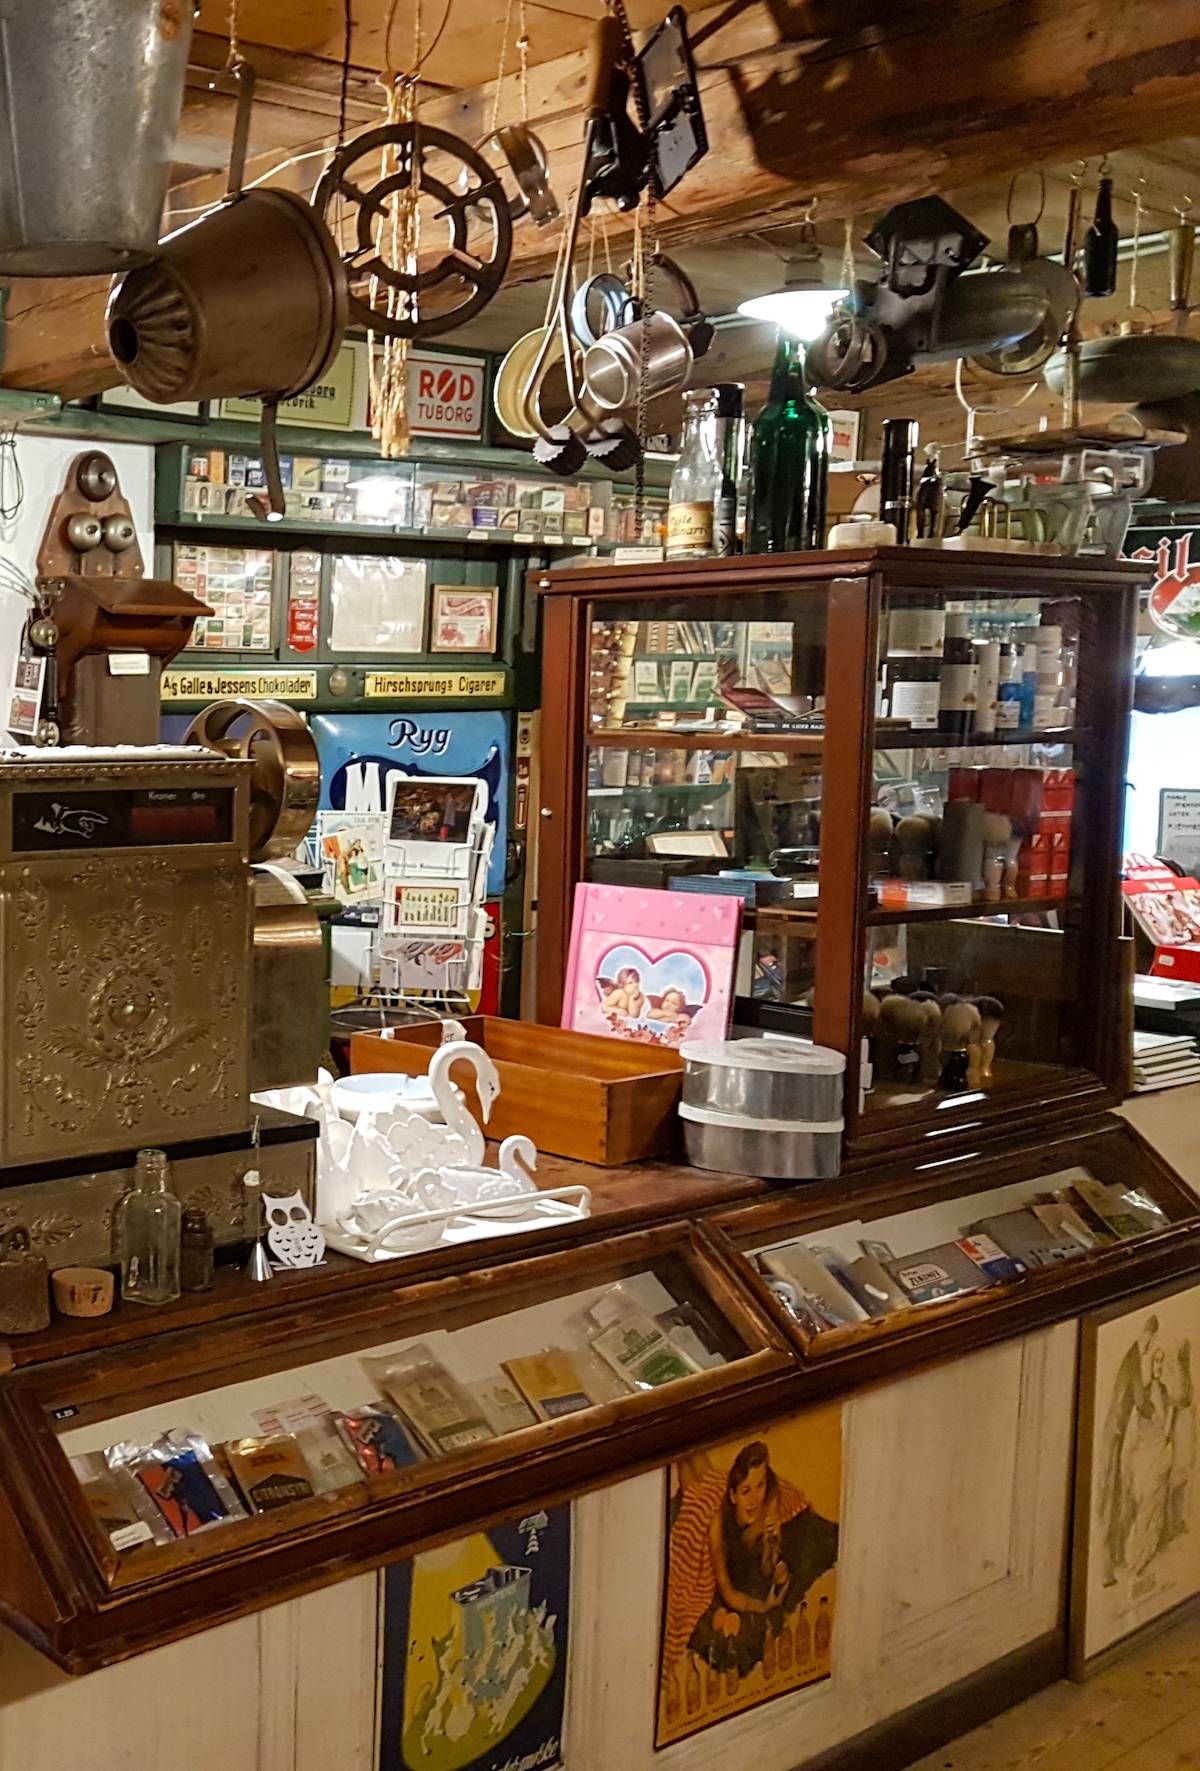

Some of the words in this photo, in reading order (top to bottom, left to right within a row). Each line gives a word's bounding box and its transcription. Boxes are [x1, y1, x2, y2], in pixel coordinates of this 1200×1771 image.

[419, 369, 475, 402] RØD
[418, 403, 473, 422] TUBORG
[180, 677, 205, 694] Galle
[214, 678, 257, 694] Jessens
[258, 677, 311, 693] Chokolader
[374, 676, 453, 694] Hirschsprungs
[458, 676, 497, 694] Cigarer
[387, 718, 452, 756] Ryg
